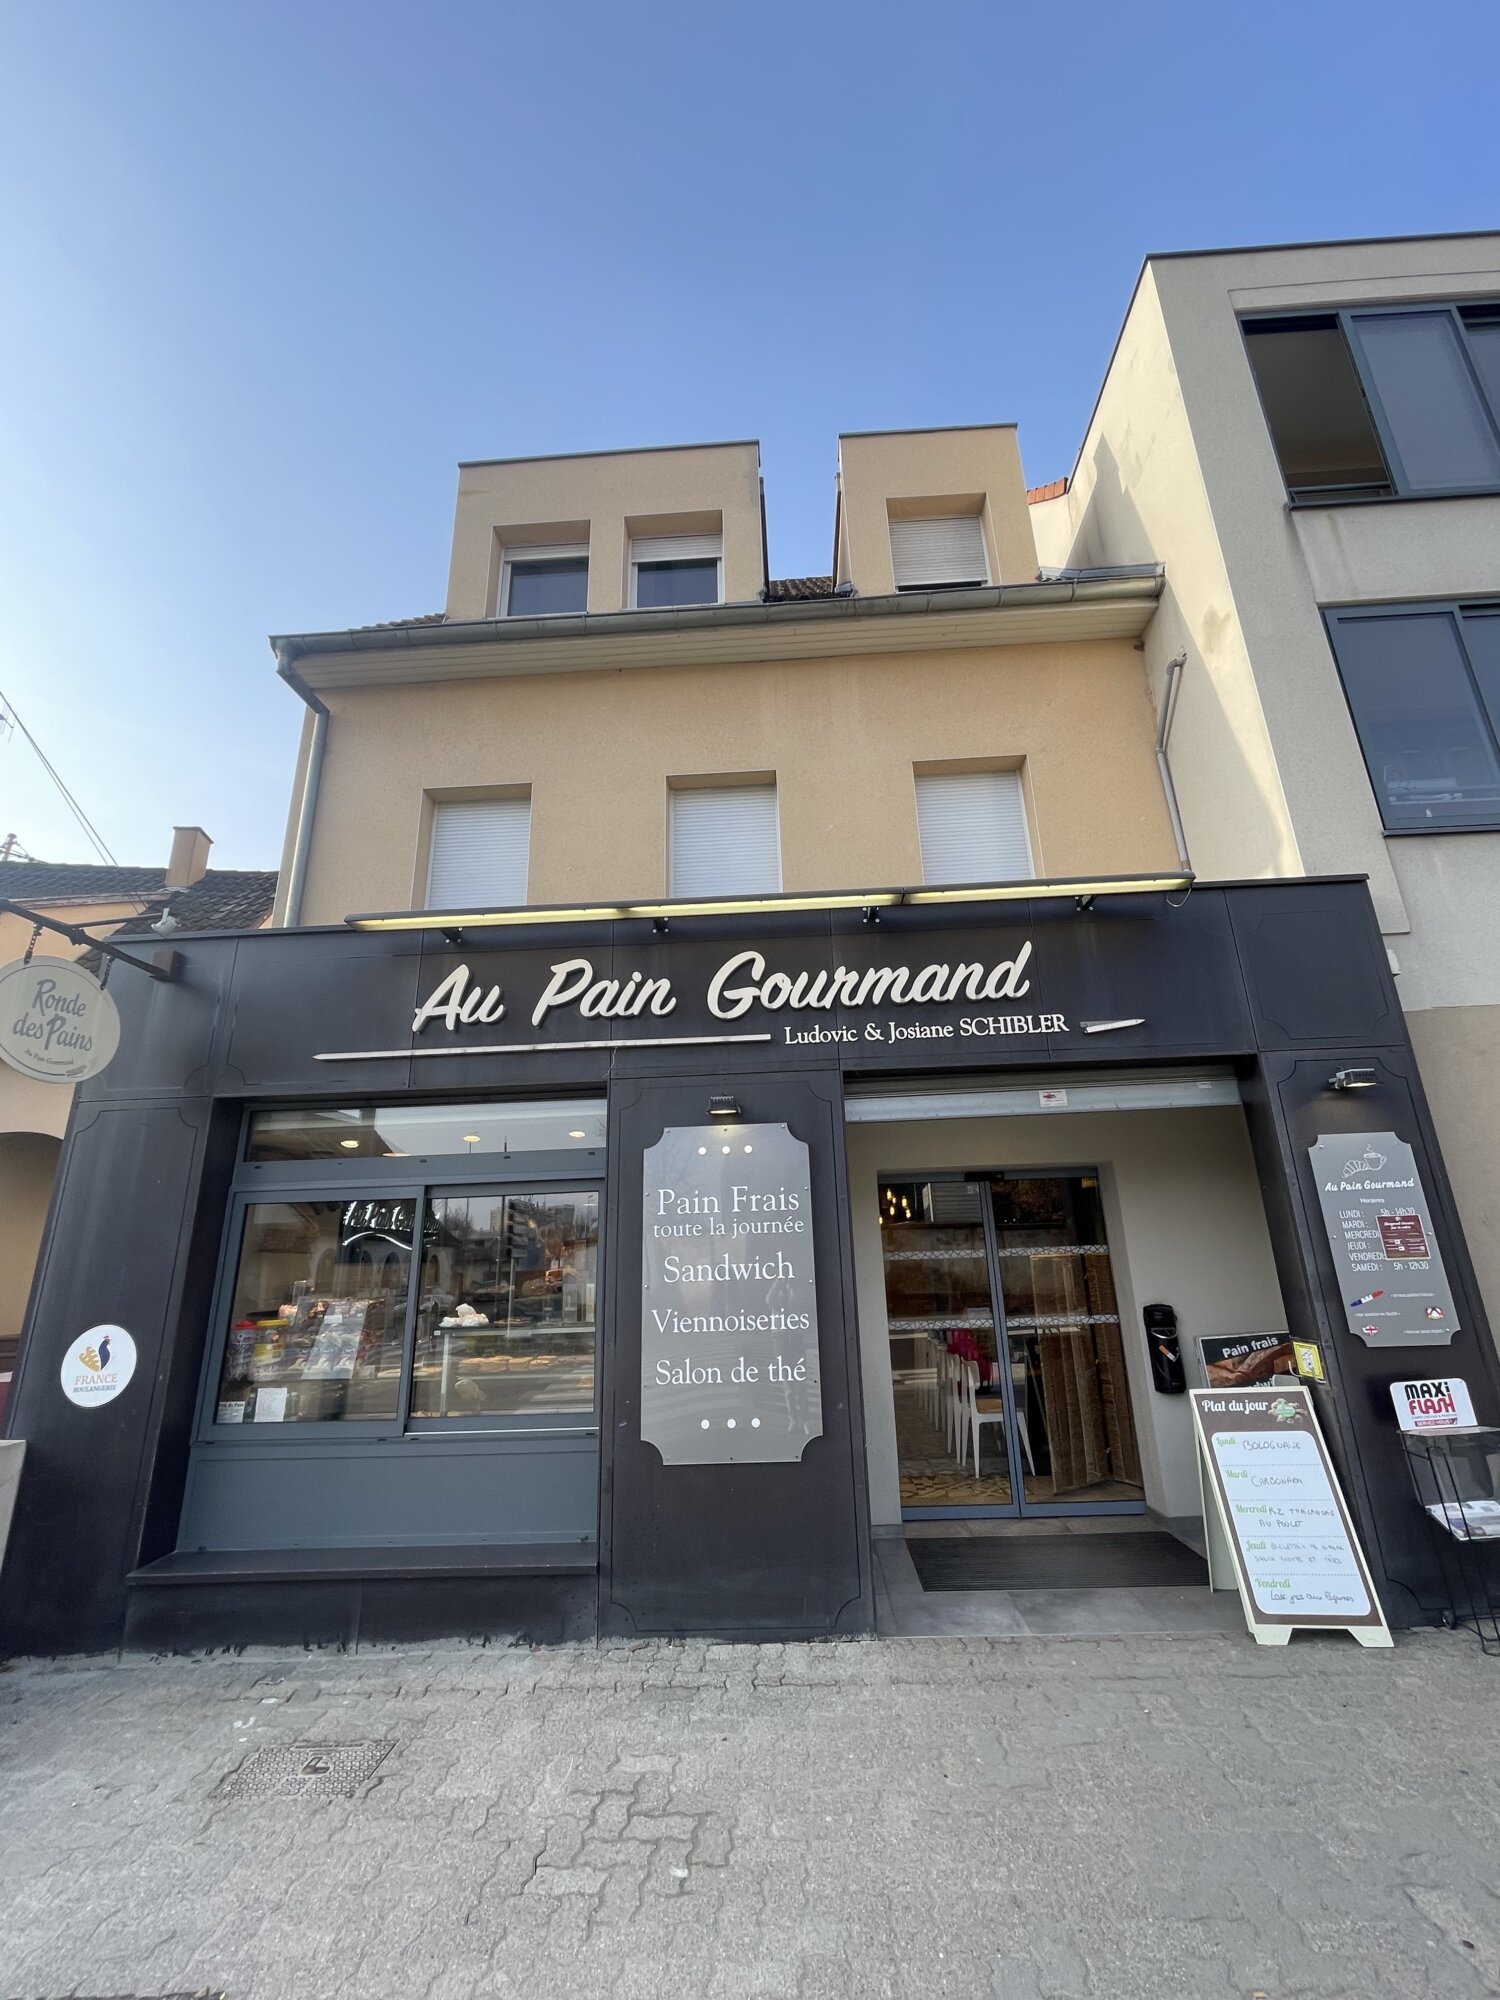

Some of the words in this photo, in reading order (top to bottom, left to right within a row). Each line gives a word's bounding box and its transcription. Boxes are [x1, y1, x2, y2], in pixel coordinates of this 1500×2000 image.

[411, 963, 504, 1032] Au
[531, 958, 677, 1027] Pain
[707, 940, 1032, 1020] Gourmand
[32, 978, 87, 1017] Ronde
[13, 1012, 43, 1040] des
[45, 1013, 93, 1052] Pains
[784, 1024, 858, 1045] Ludovic
[864, 1023, 884, 1041] &
[888, 1021, 953, 1040] Josiane
[959, 1013, 1070, 1037] SCHIBLER
[1324, 1182, 1338, 1192] Au
[1340, 1181, 1362, 1191] Pain
[1364, 1177, 1415, 1190] Gourmand
[657, 1188, 721, 1216] Pain
[731, 1185, 801, 1213] Frais
[1339, 1209, 1361, 1219] LUNDI
[1342, 1220, 1365, 1229] MARDI
[653, 1220, 702, 1239] toute
[709, 1217, 726, 1236] la
[732, 1216, 805, 1240] journée
[1347, 1241, 1367, 1251] JEUDI
[663, 1251, 795, 1283] Sandwich
[1351, 1262, 1379, 1272] SAMEDI
[1393, 1261, 1403, 1271] 5h
[1408, 1260, 1429, 1270] 12h30
[651, 1307, 810, 1334] Viennoiseries
[1222, 1344, 1250, 1359] Pain
[1251, 1336, 1279, 1351] frais
[74, 1373, 118, 1386] FRANCE
[655, 1358, 723, 1386] Salon
[731, 1356, 759, 1384] de
[768, 1354, 807, 1382] thé
[1201, 1399, 1226, 1412] Plat
[1229, 1399, 1246, 1412] du
[1244, 1399, 1269, 1415] jour
[1409, 1393, 1456, 1415] FLASH
[1225, 1470, 1248, 1478] Mardi
[1235, 1504, 1268, 1513] Mercredi
[1255, 1578, 1291, 1588] Vendredi
